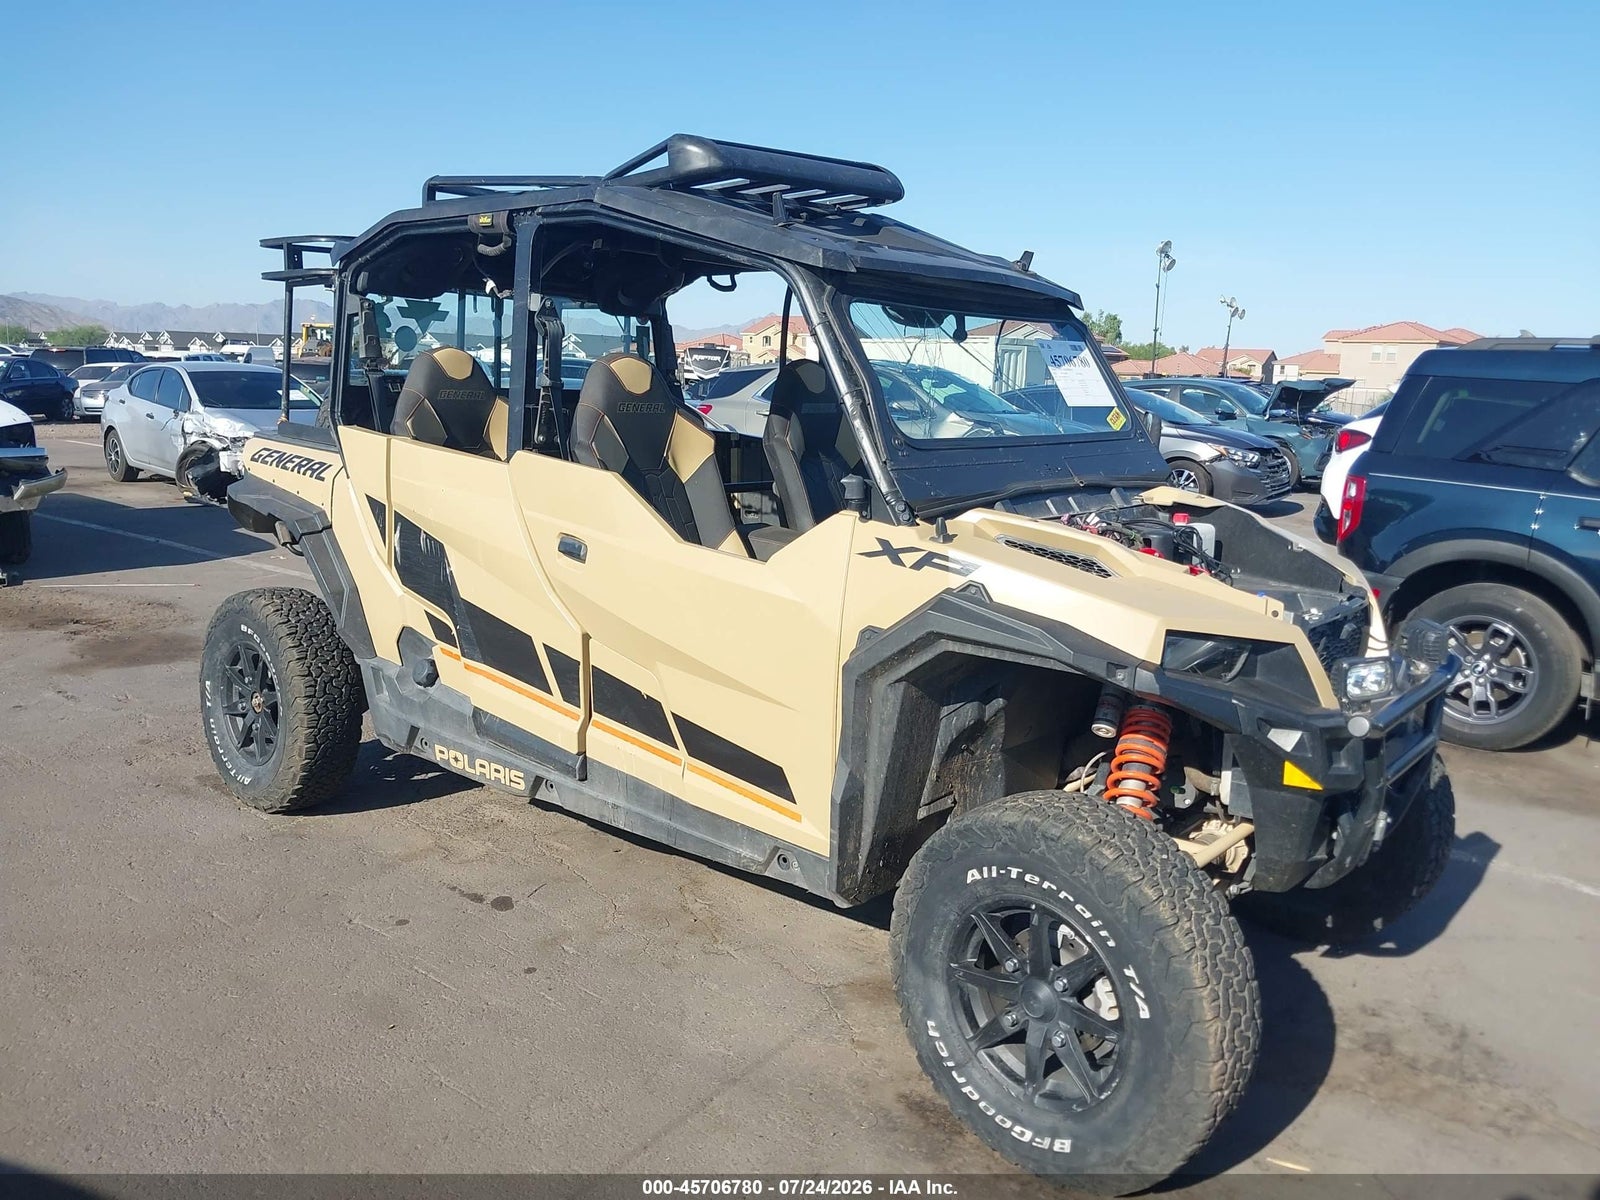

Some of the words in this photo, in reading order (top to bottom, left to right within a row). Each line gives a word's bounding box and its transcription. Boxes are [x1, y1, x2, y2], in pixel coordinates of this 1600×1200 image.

[692, 354, 721, 362] RAPTOR
[1049, 355, 1091, 369] 45706780
[438, 390, 487, 400] GENERAL
[617, 402, 666, 413] GENERAL
[250, 447, 333, 482] GENERAL
[854, 537, 981, 577] XP
[210, 718, 252, 786] All-Terrain
[435, 744, 526, 791] POLARIS
[966, 865, 1116, 949] All-Terrain
[1123, 964, 1151, 1019] T/A
[926, 1020, 1072, 1154] BFGoodrich
